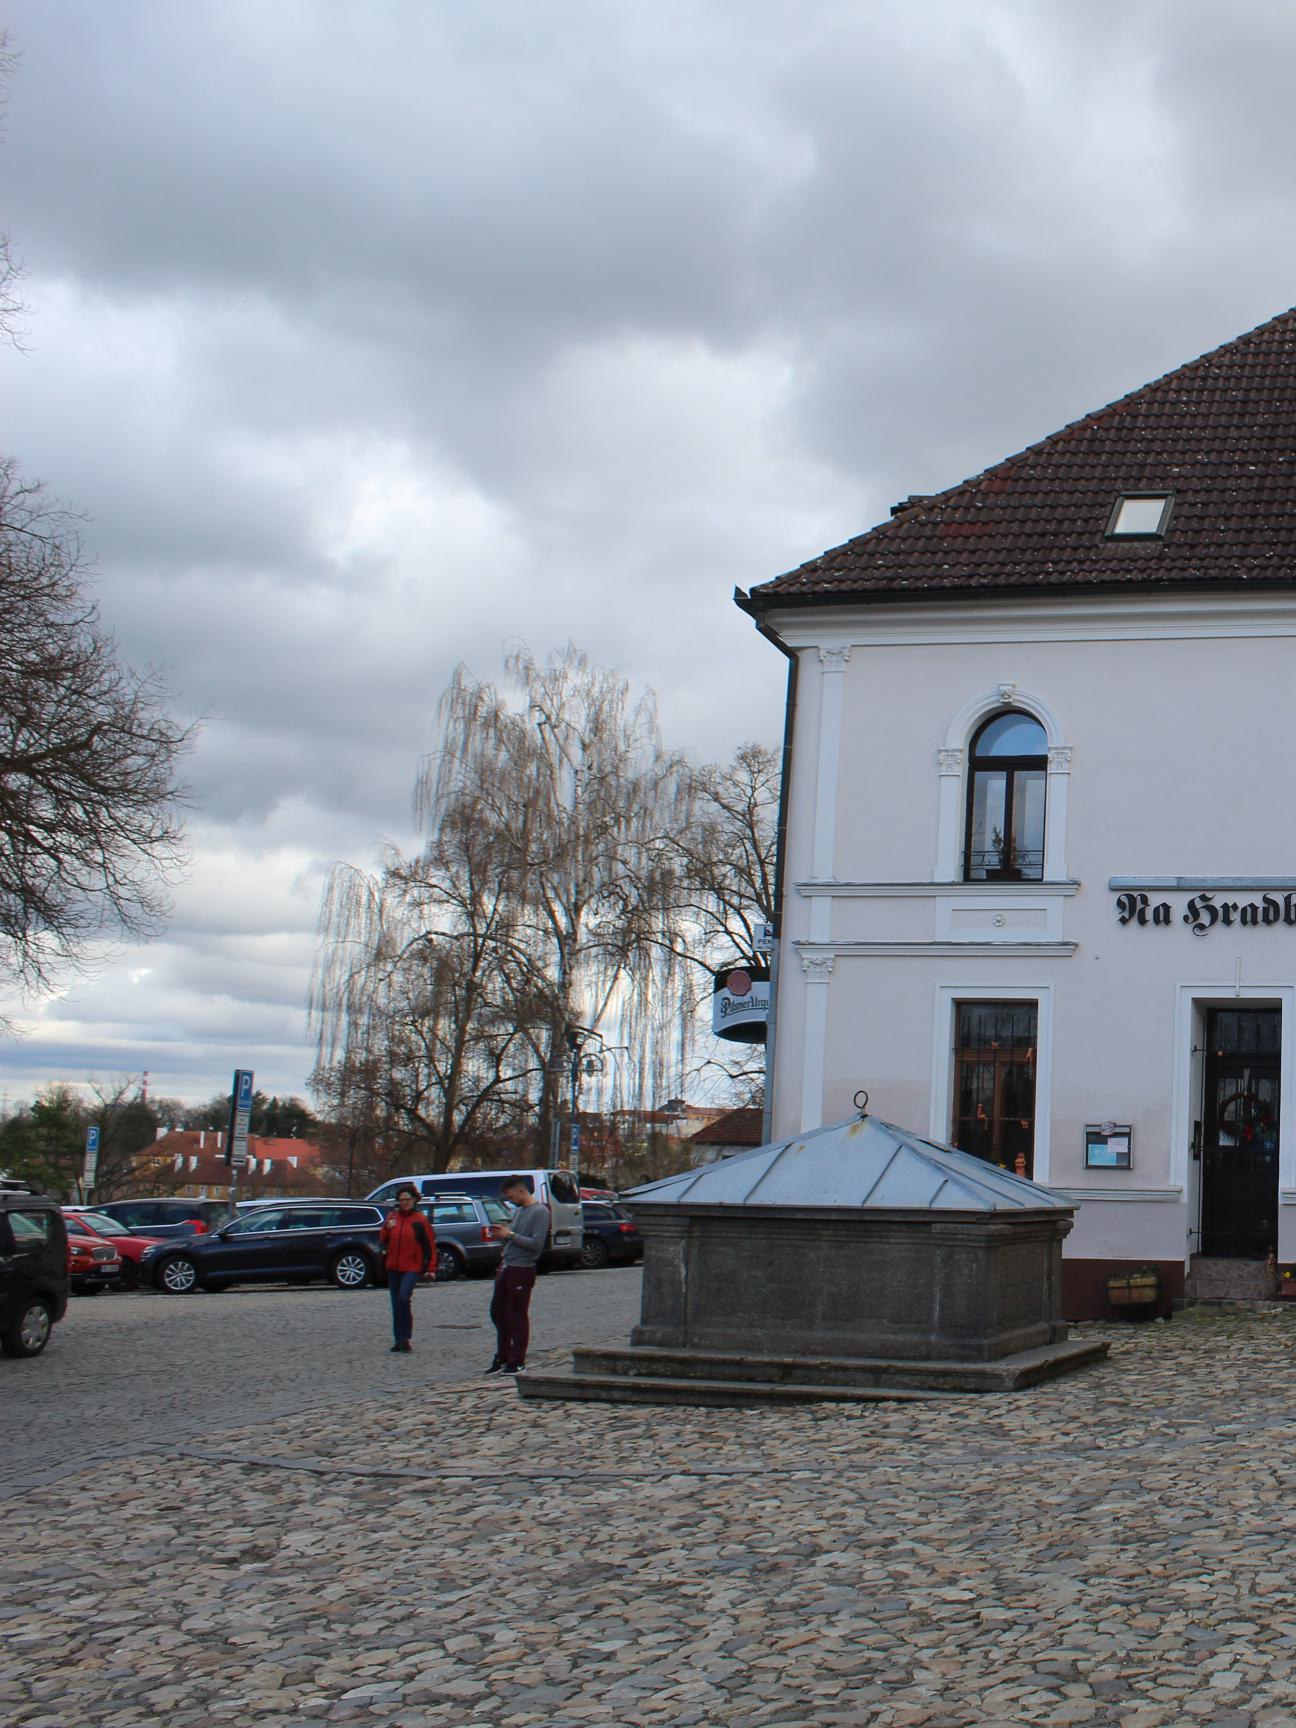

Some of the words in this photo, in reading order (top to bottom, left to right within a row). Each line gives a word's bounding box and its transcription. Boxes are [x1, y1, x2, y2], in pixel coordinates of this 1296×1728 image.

[1116, 893, 1173, 927] Na
[720, 997, 751, 1019] Pilsner
[241, 1074, 251, 1097] P
[89, 1130, 97, 1145] P
